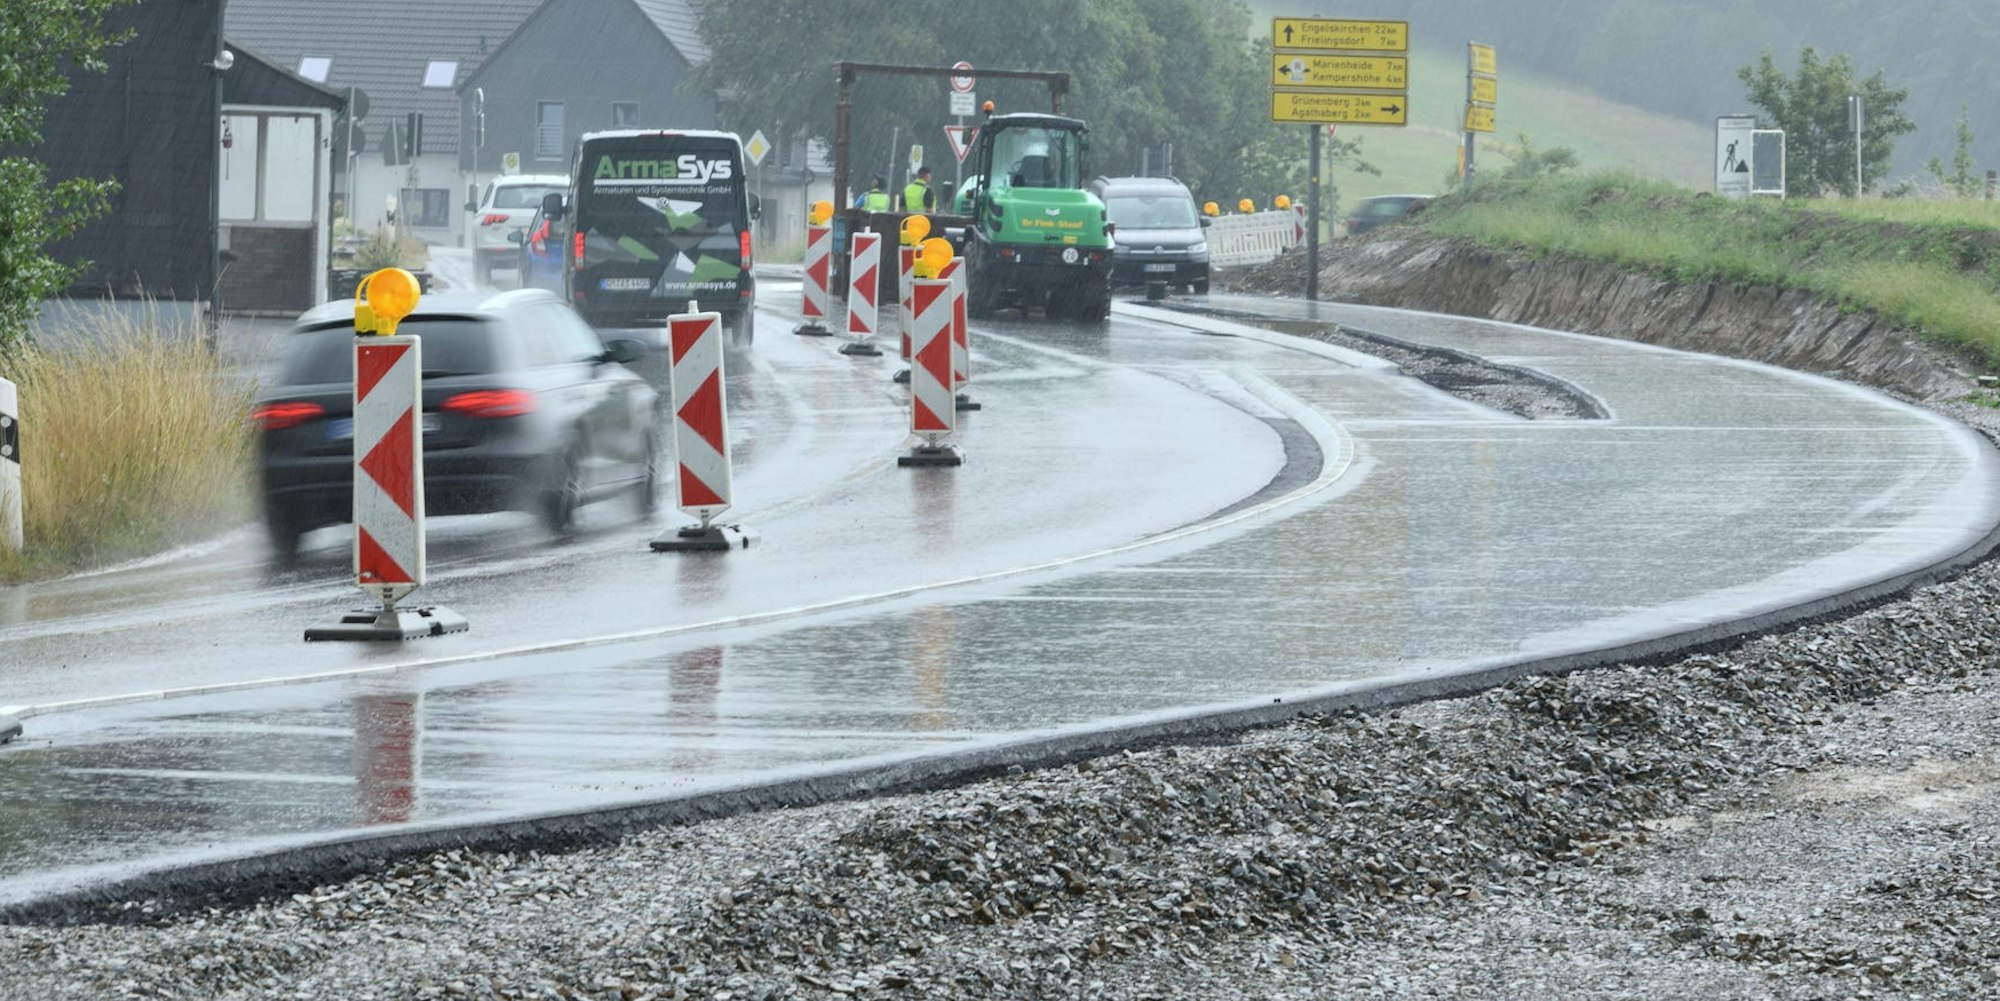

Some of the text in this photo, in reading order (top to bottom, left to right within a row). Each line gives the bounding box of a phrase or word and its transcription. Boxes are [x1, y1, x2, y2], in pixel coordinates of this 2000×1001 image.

[1302, 23, 1371, 33] Engelskirchen
[1301, 35, 1365, 46] Frielingsdorf
[1313, 60, 1373, 70] Marienheide
[1313, 72, 1381, 83] Kempershöhe
[1292, 96, 1350, 107] Grünenberg
[1292, 108, 1349, 119] Agathaberg
[593, 154, 732, 184] ArmaSys
[594, 186, 732, 196] Armaturen und Systemtechnik GmbH
[665, 281, 737, 291] www.armasys.de
